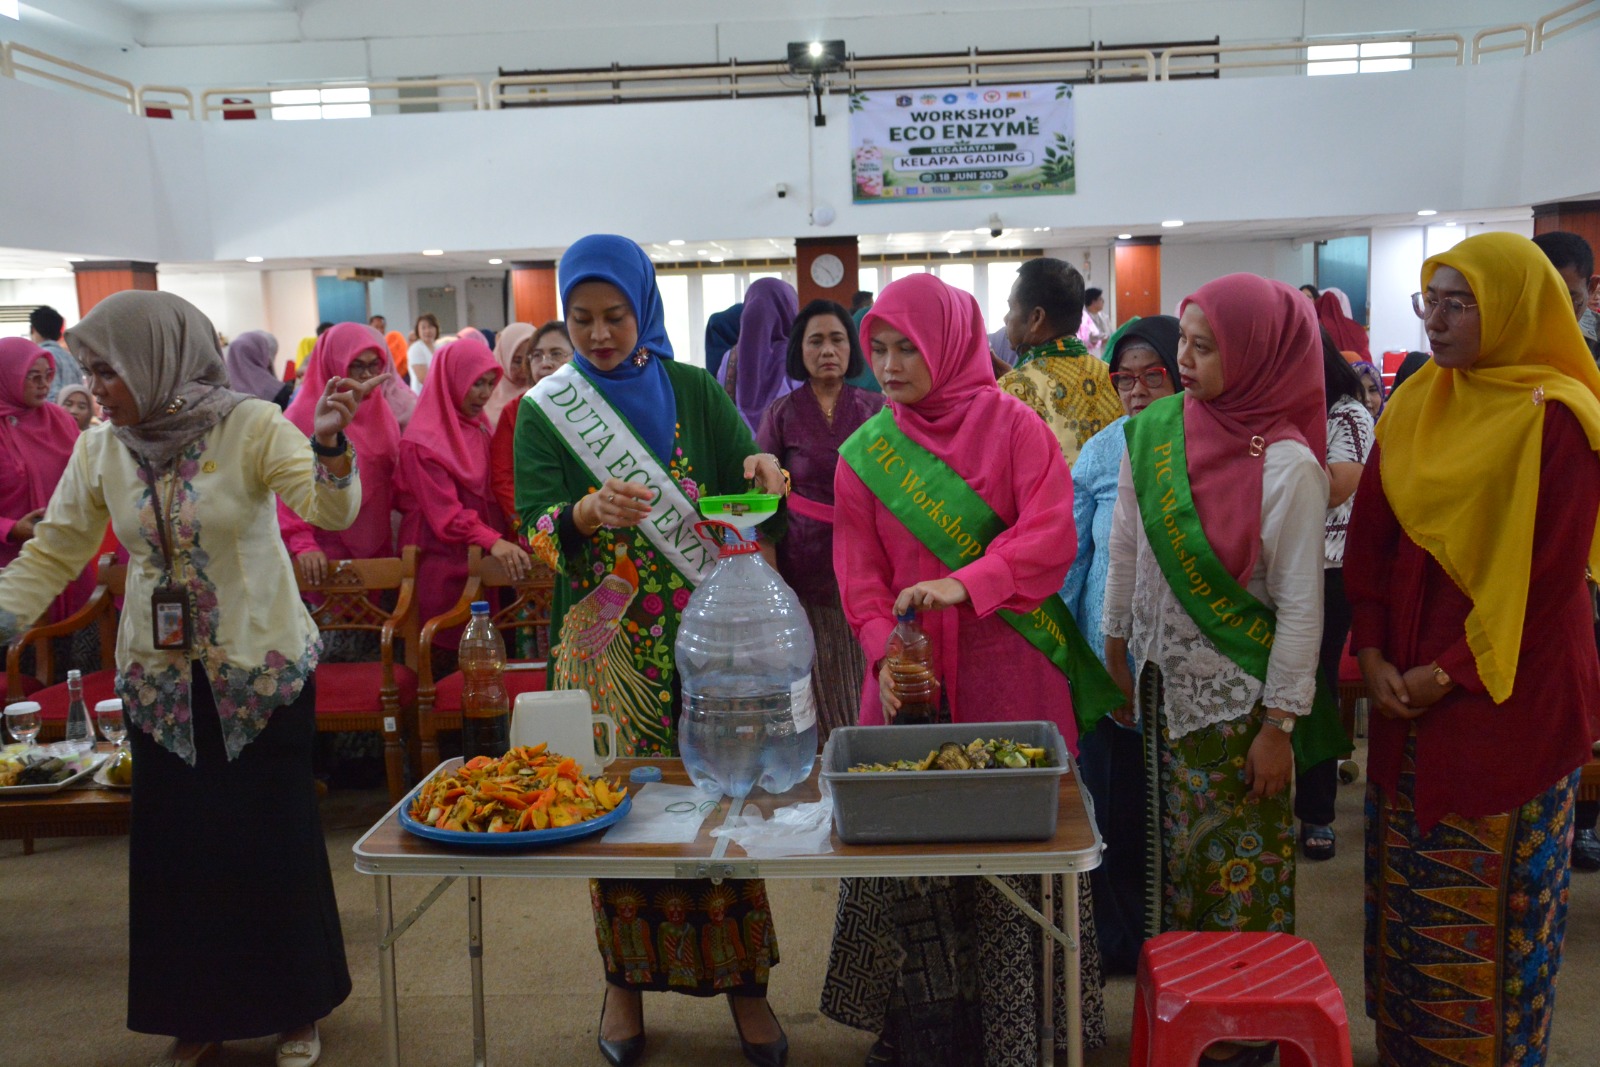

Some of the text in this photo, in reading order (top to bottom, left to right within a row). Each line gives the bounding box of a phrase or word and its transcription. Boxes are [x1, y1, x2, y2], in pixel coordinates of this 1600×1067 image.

[910, 107, 1016, 122] WORKSHOP
[889, 121, 1039, 142] ECO ENZYME
[931, 144, 995, 154] KECAMATAN
[901, 152, 1026, 168] KELAPA GADING
[938, 171, 1004, 181] 18 JUNI 2026
[547, 382, 616, 460] DUTA
[651, 504, 717, 575] ENZY
[867, 436, 1066, 646] PIC Workshop zyme
[1154, 440, 1244, 628] PIC Workshop Eco
